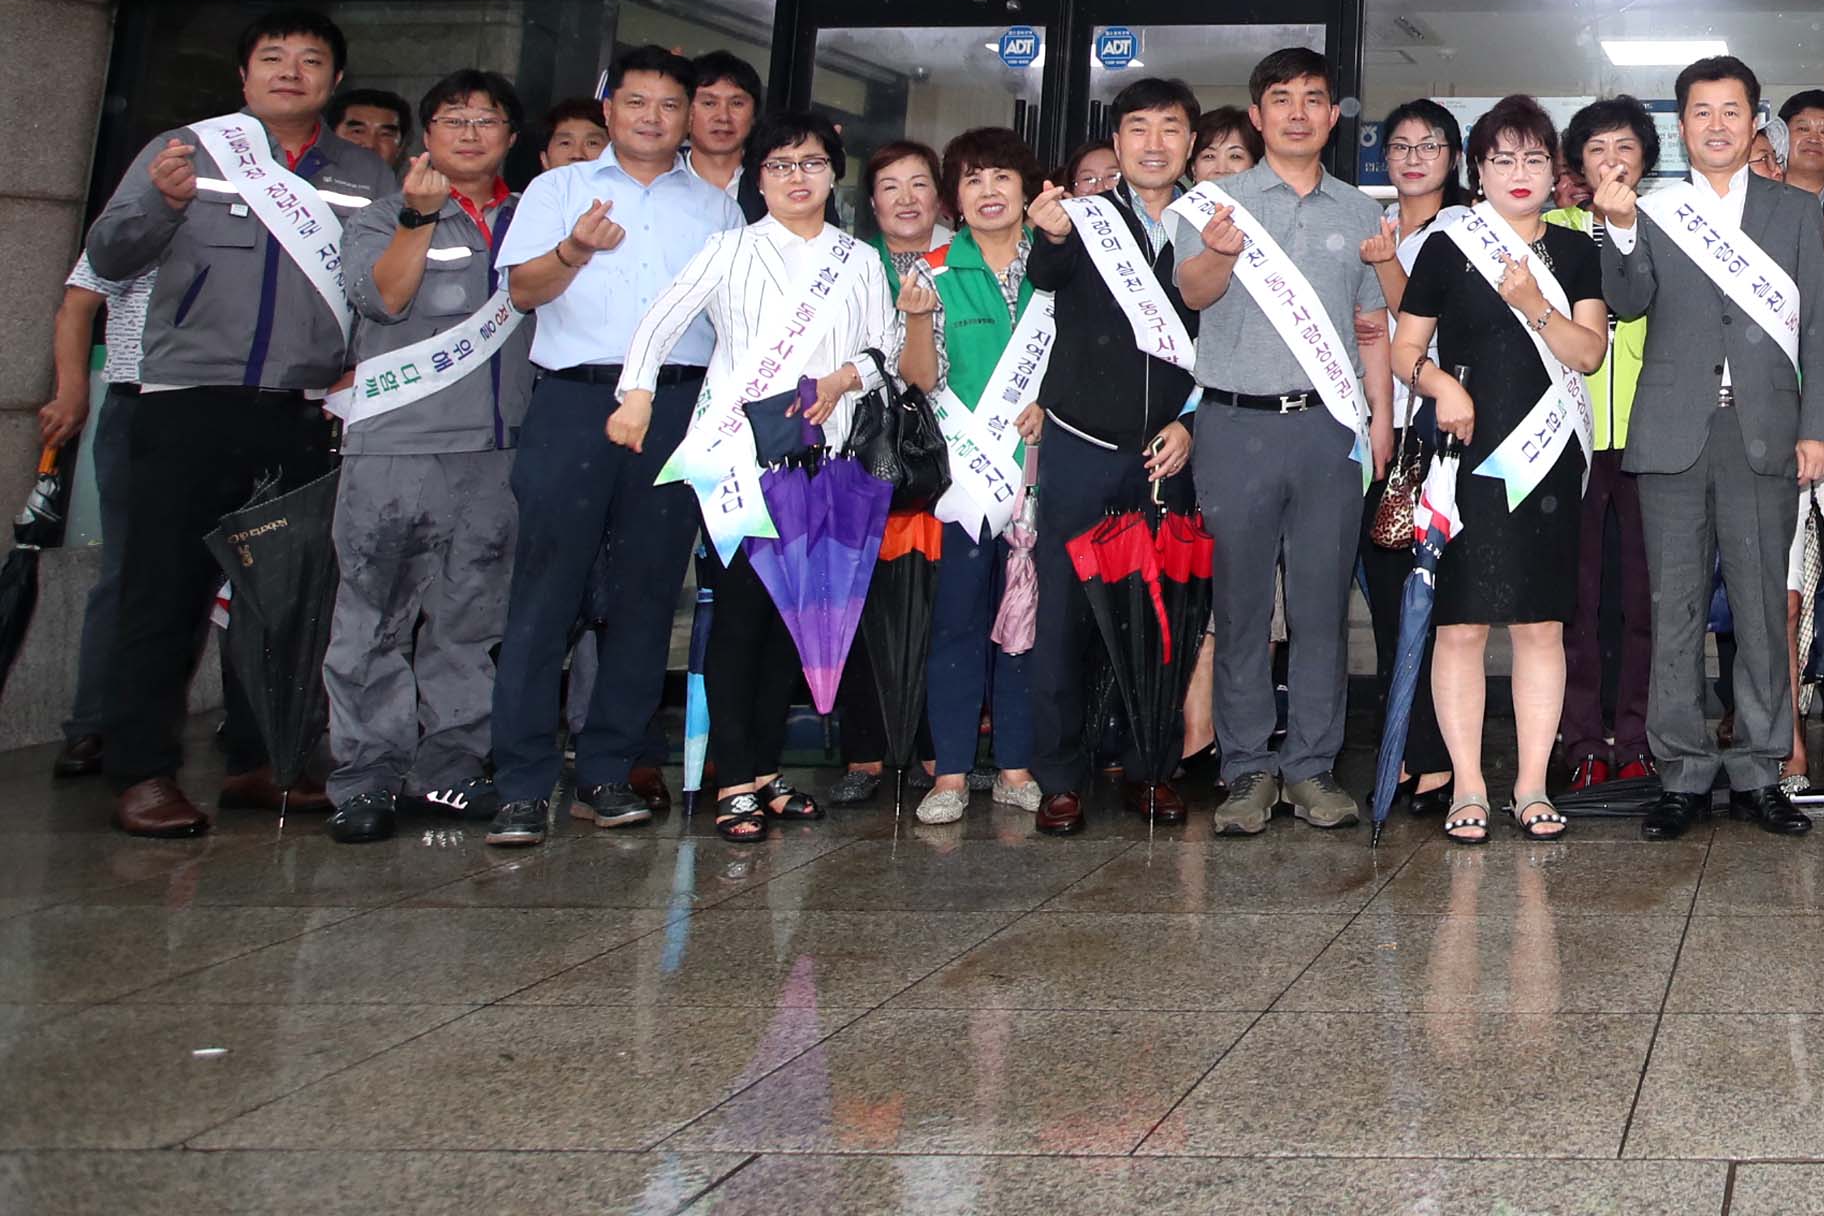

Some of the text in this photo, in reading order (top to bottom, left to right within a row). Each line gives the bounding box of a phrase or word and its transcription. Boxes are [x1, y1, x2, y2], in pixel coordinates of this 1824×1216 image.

[1006, 39, 1034, 54] ADT
[1102, 39, 1131, 55] ADT
[219, 126, 266, 180] 전통시장
[264, 182, 322, 239] 장보기로
[1674, 202, 1750, 278] 지역사랑의
[1751, 275, 1787, 313] 실천
[810, 266, 839, 299] 실천
[1116, 261, 1144, 293] 실천
[432, 339, 474, 373] 위해
[1002, 329, 1051, 405] 지역경제를
[365, 363, 422, 398] 다함께
[945, 430, 1015, 502] 노력합시다
